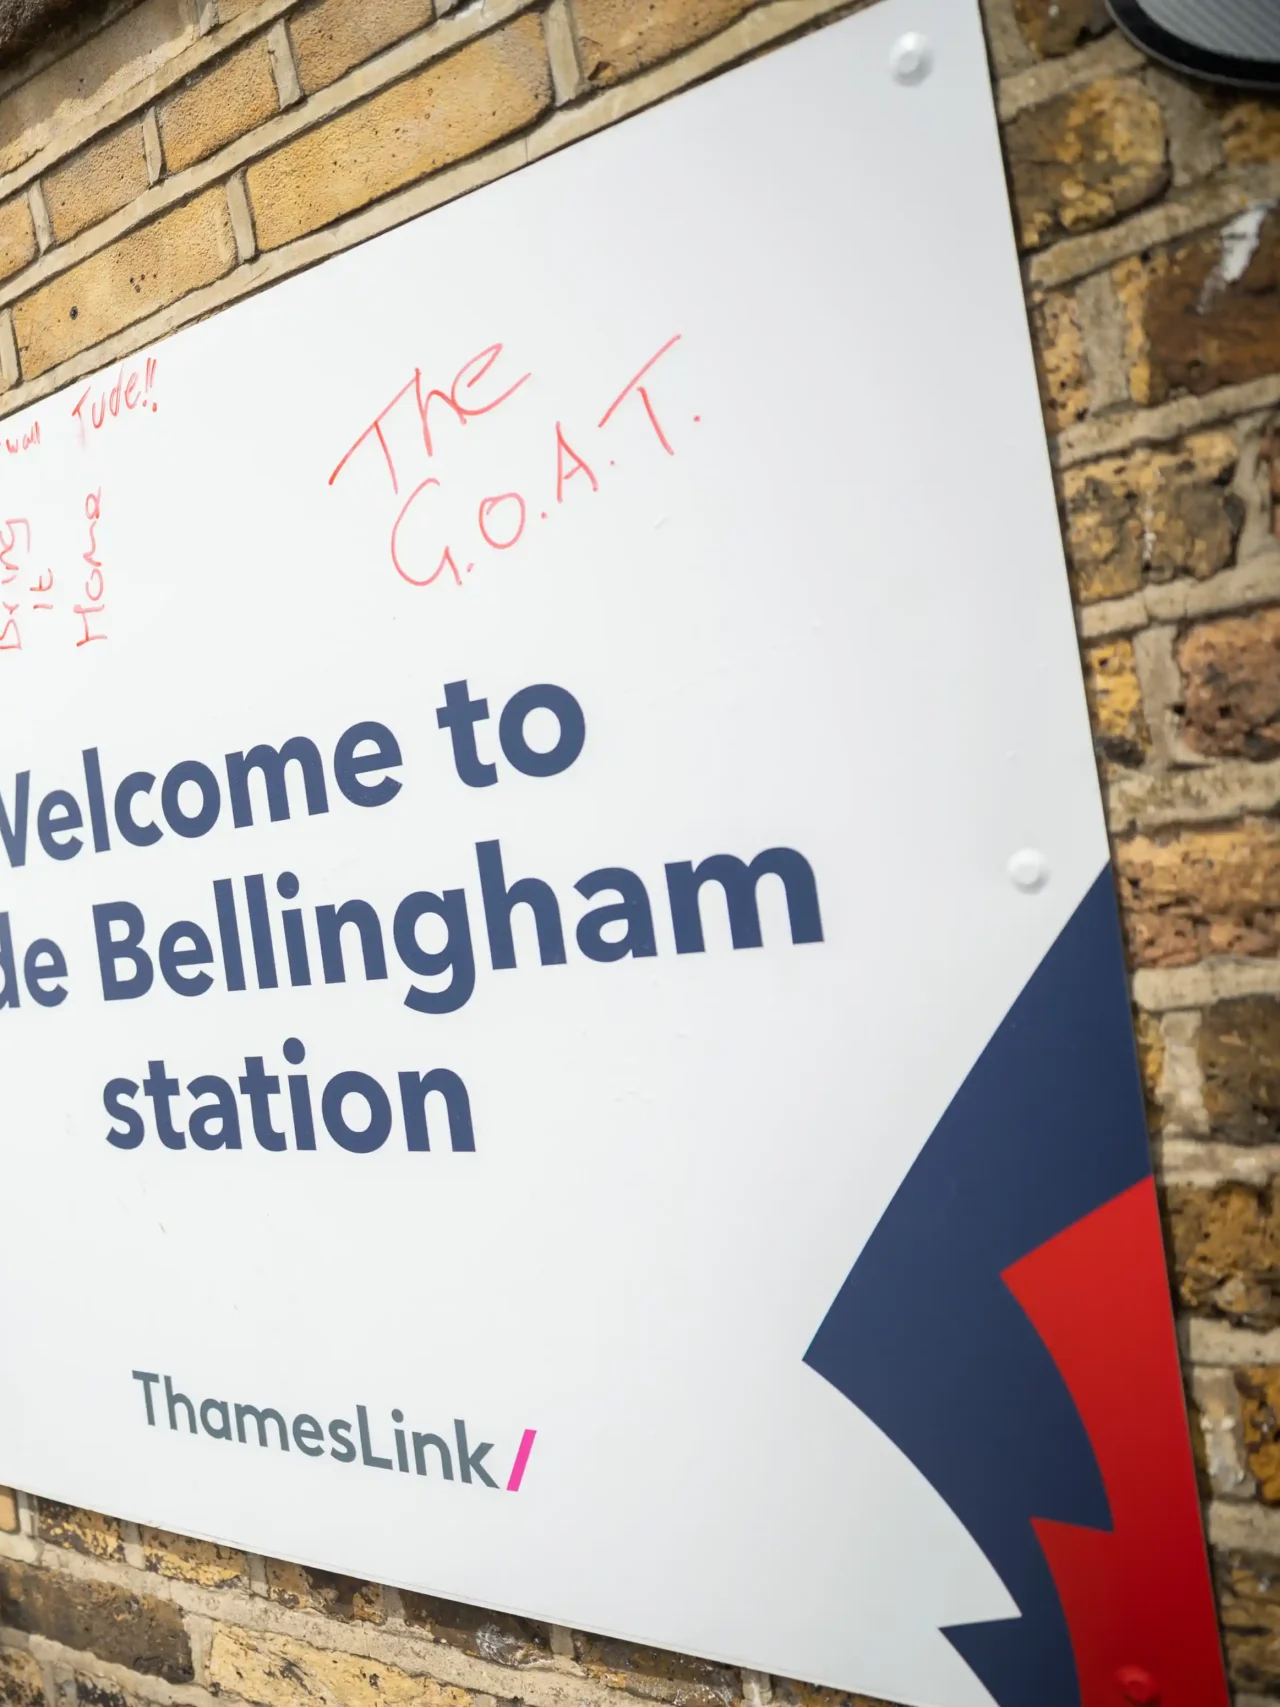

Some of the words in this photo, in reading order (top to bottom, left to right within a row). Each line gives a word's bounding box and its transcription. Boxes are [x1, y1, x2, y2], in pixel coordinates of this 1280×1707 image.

[329, 342, 533, 495] The
[390, 333, 706, 588] G.O.A.T.
[436, 679, 586, 788] to
[93, 839, 825, 1015] Bellingham
[103, 1036, 477, 1154] station
